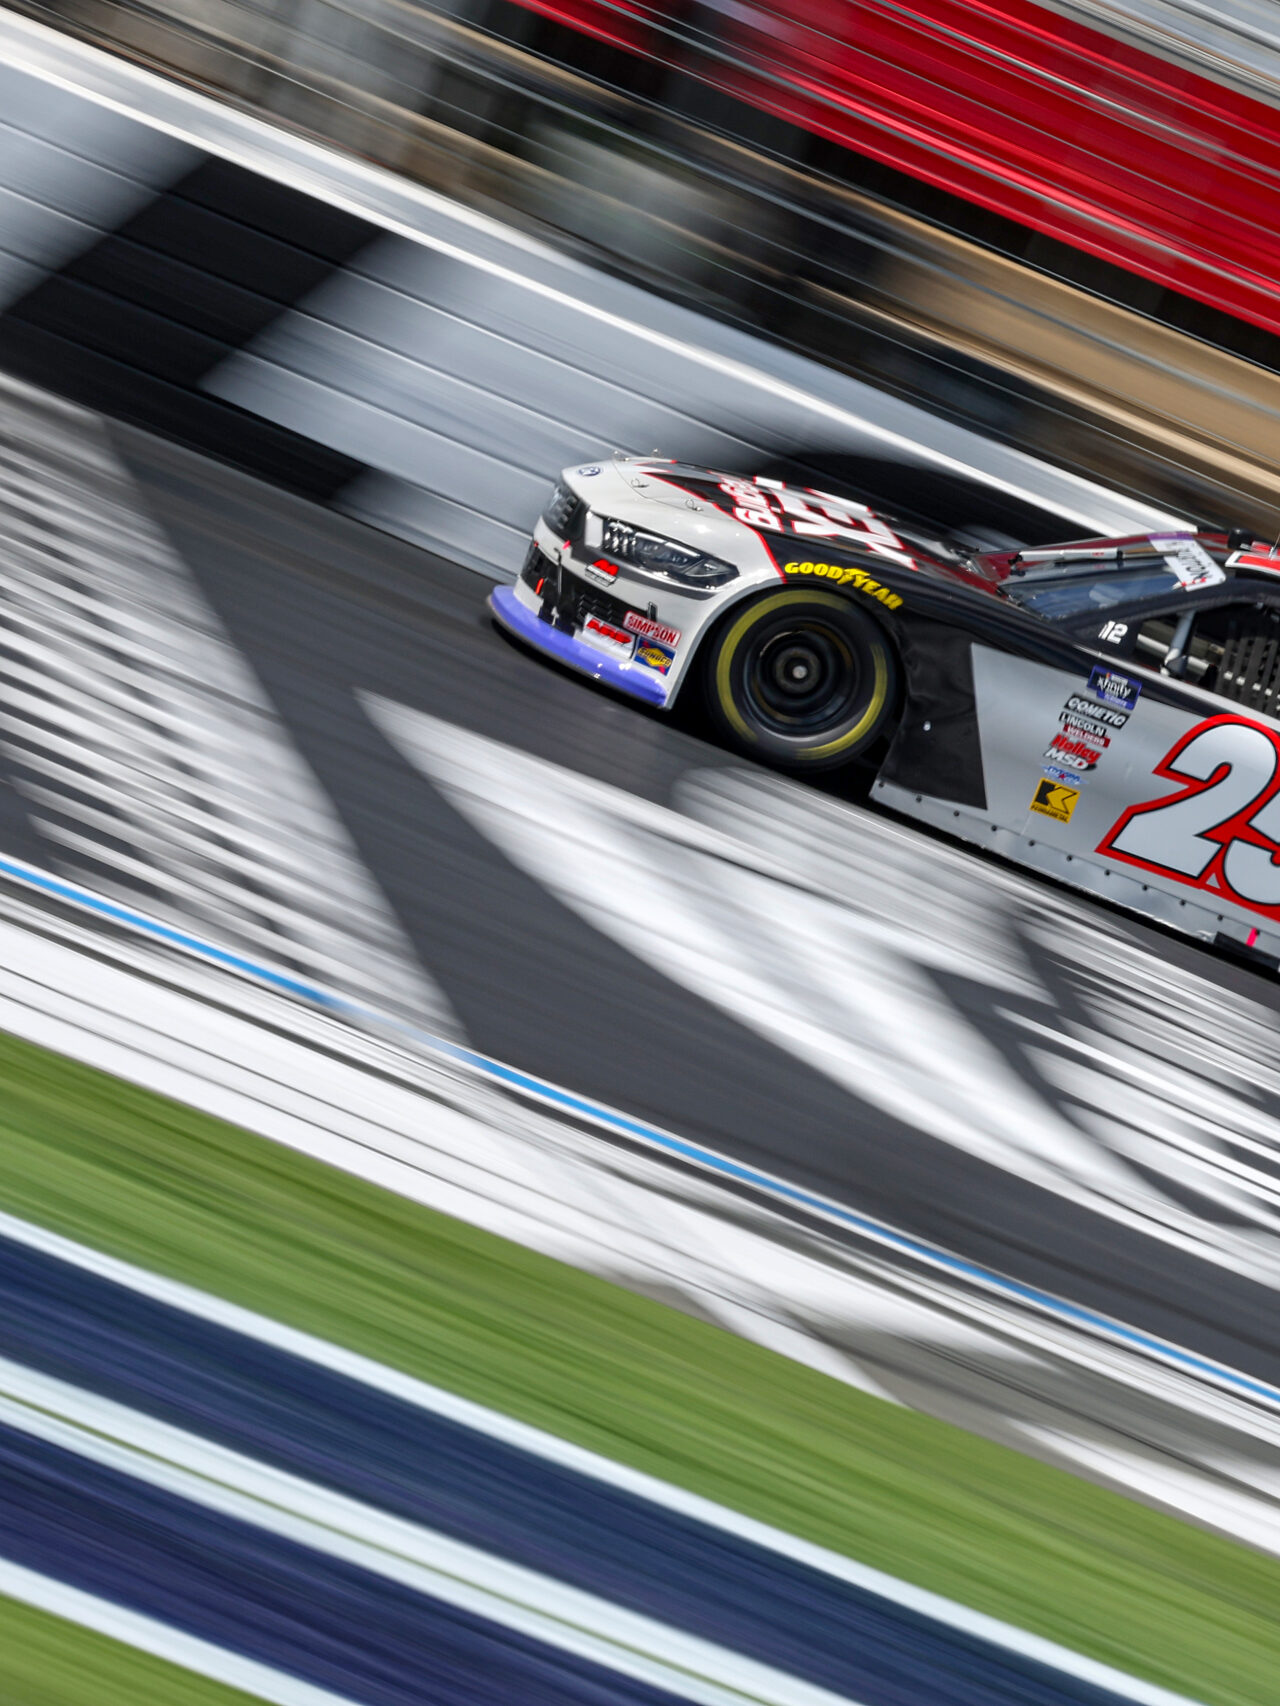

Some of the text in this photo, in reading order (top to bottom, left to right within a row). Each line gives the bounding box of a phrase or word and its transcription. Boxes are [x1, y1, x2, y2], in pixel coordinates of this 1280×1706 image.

[784, 561, 903, 610] GOODYEAR
[629, 615, 677, 644] SIMPSON
[1061, 712, 1105, 737] LINCOLN
[1068, 697, 1126, 726] COMETIC
[1051, 734, 1102, 764] Holley
[1067, 726, 1106, 745] WELDERS
[1043, 747, 1088, 770] MSD
